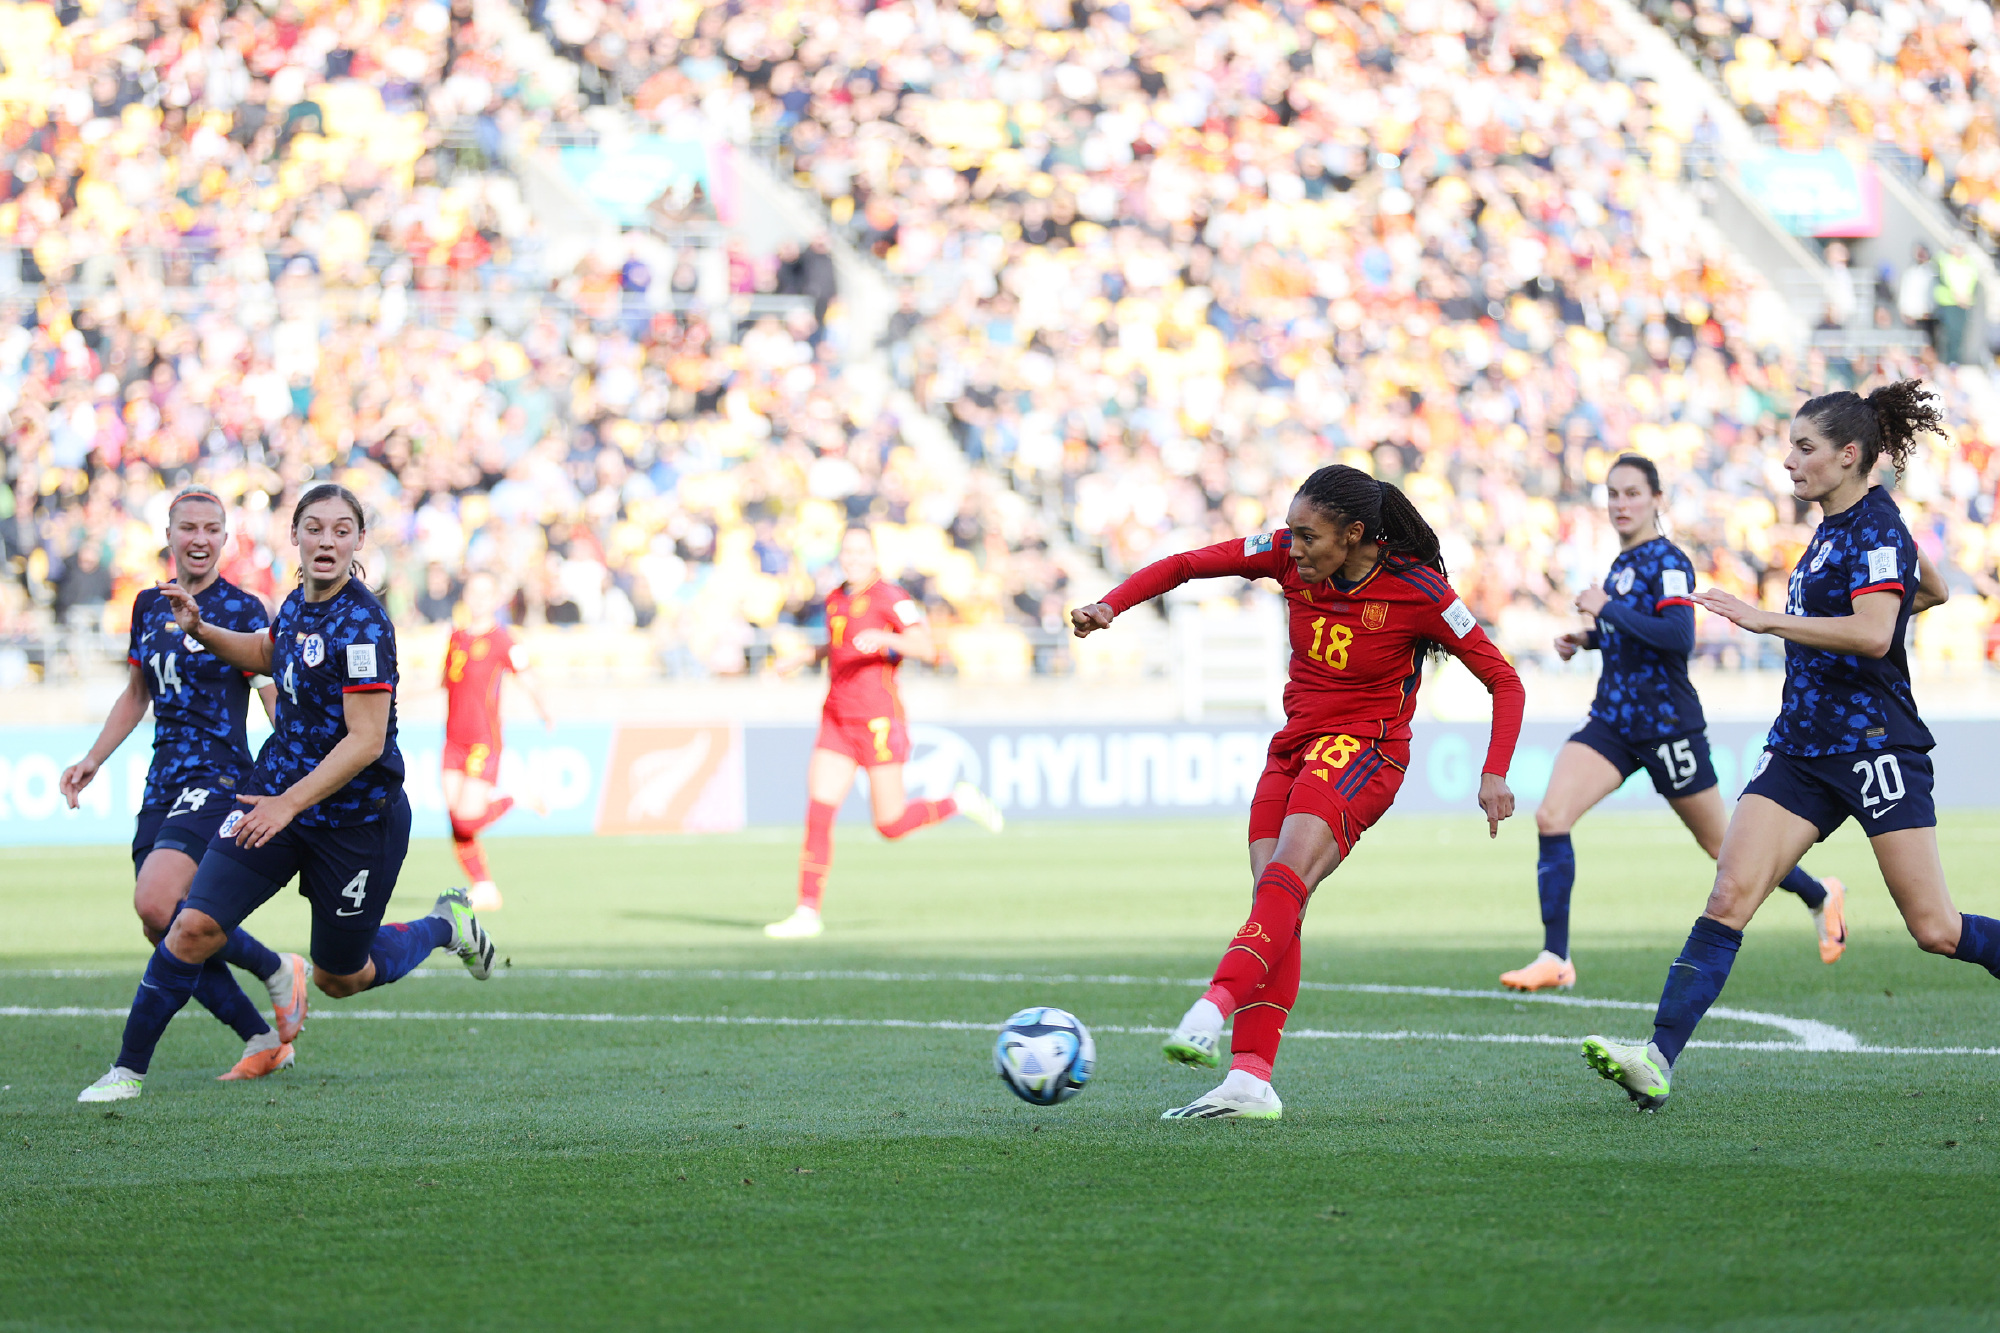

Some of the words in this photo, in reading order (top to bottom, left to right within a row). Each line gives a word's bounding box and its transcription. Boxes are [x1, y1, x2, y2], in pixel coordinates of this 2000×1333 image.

[1308, 616, 1354, 671] 18
[149, 652, 182, 695] 14
[283, 661, 298, 705] 4
[988, 733, 1272, 809] HYUNDA
[1304, 734, 1361, 769] 18
[1656, 738, 1698, 781] 15
[172, 787, 211, 812] 14
[1852, 754, 1906, 808] 20
[341, 869, 370, 908] 4
